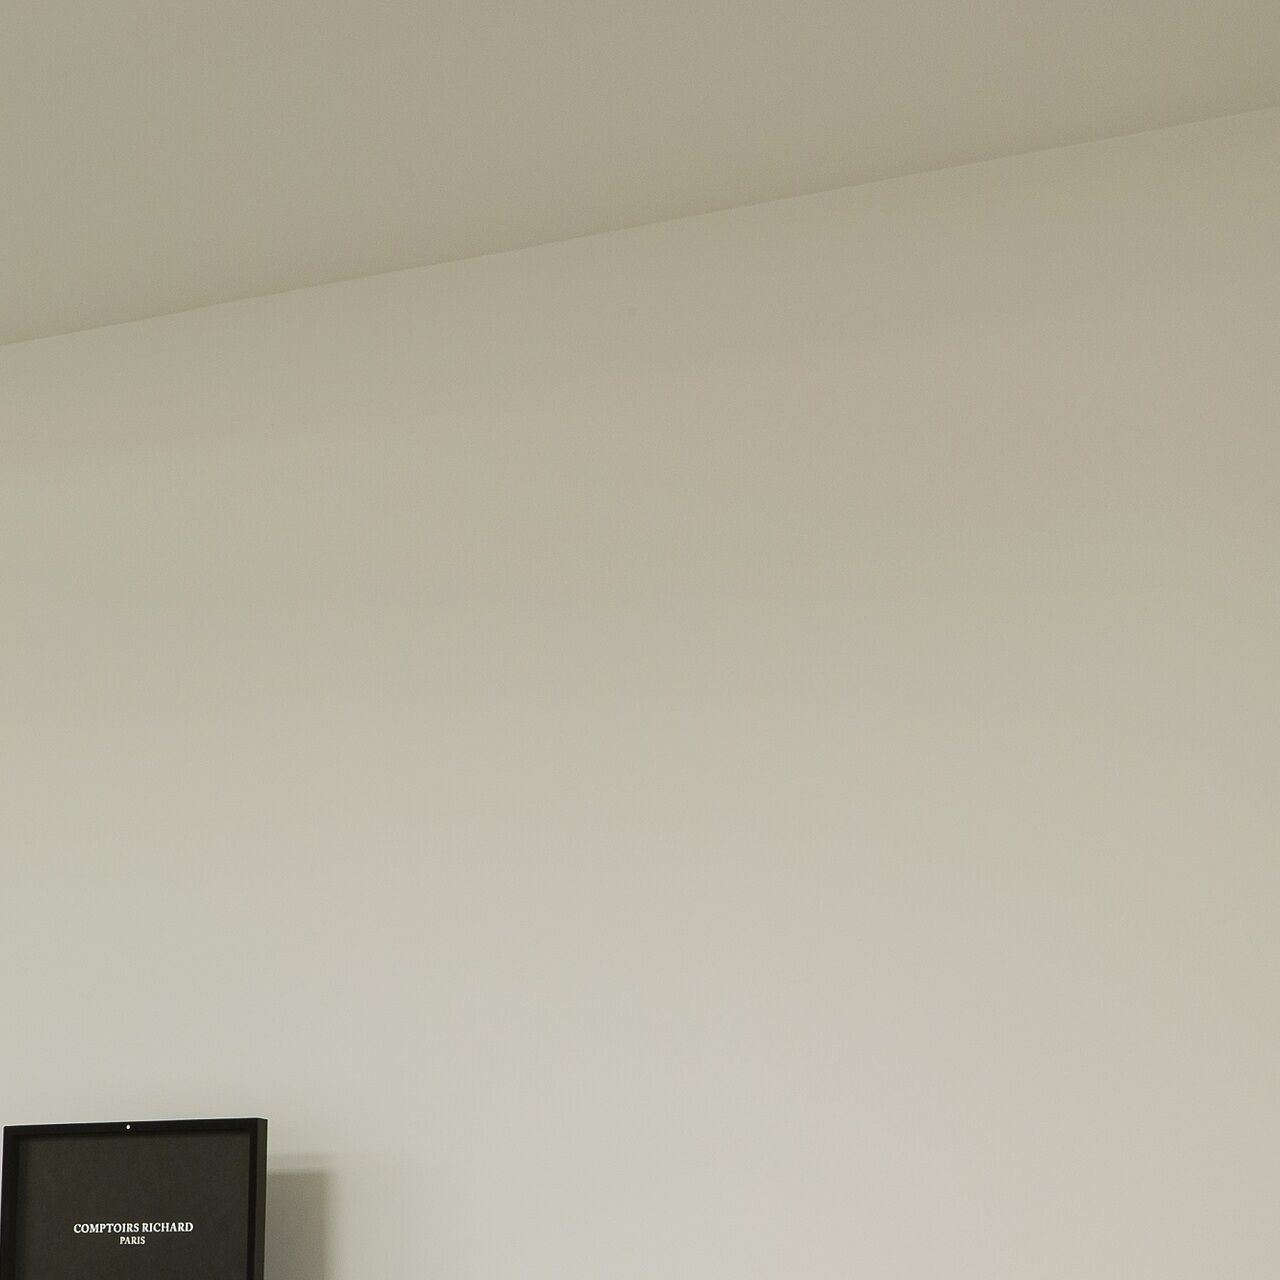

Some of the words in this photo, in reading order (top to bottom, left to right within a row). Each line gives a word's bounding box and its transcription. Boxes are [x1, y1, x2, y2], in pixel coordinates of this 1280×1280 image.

[73, 1223, 140, 1233] COMPTOIRS
[142, 1222, 194, 1232] RICHARD
[119, 1236, 146, 1245] PARIS
